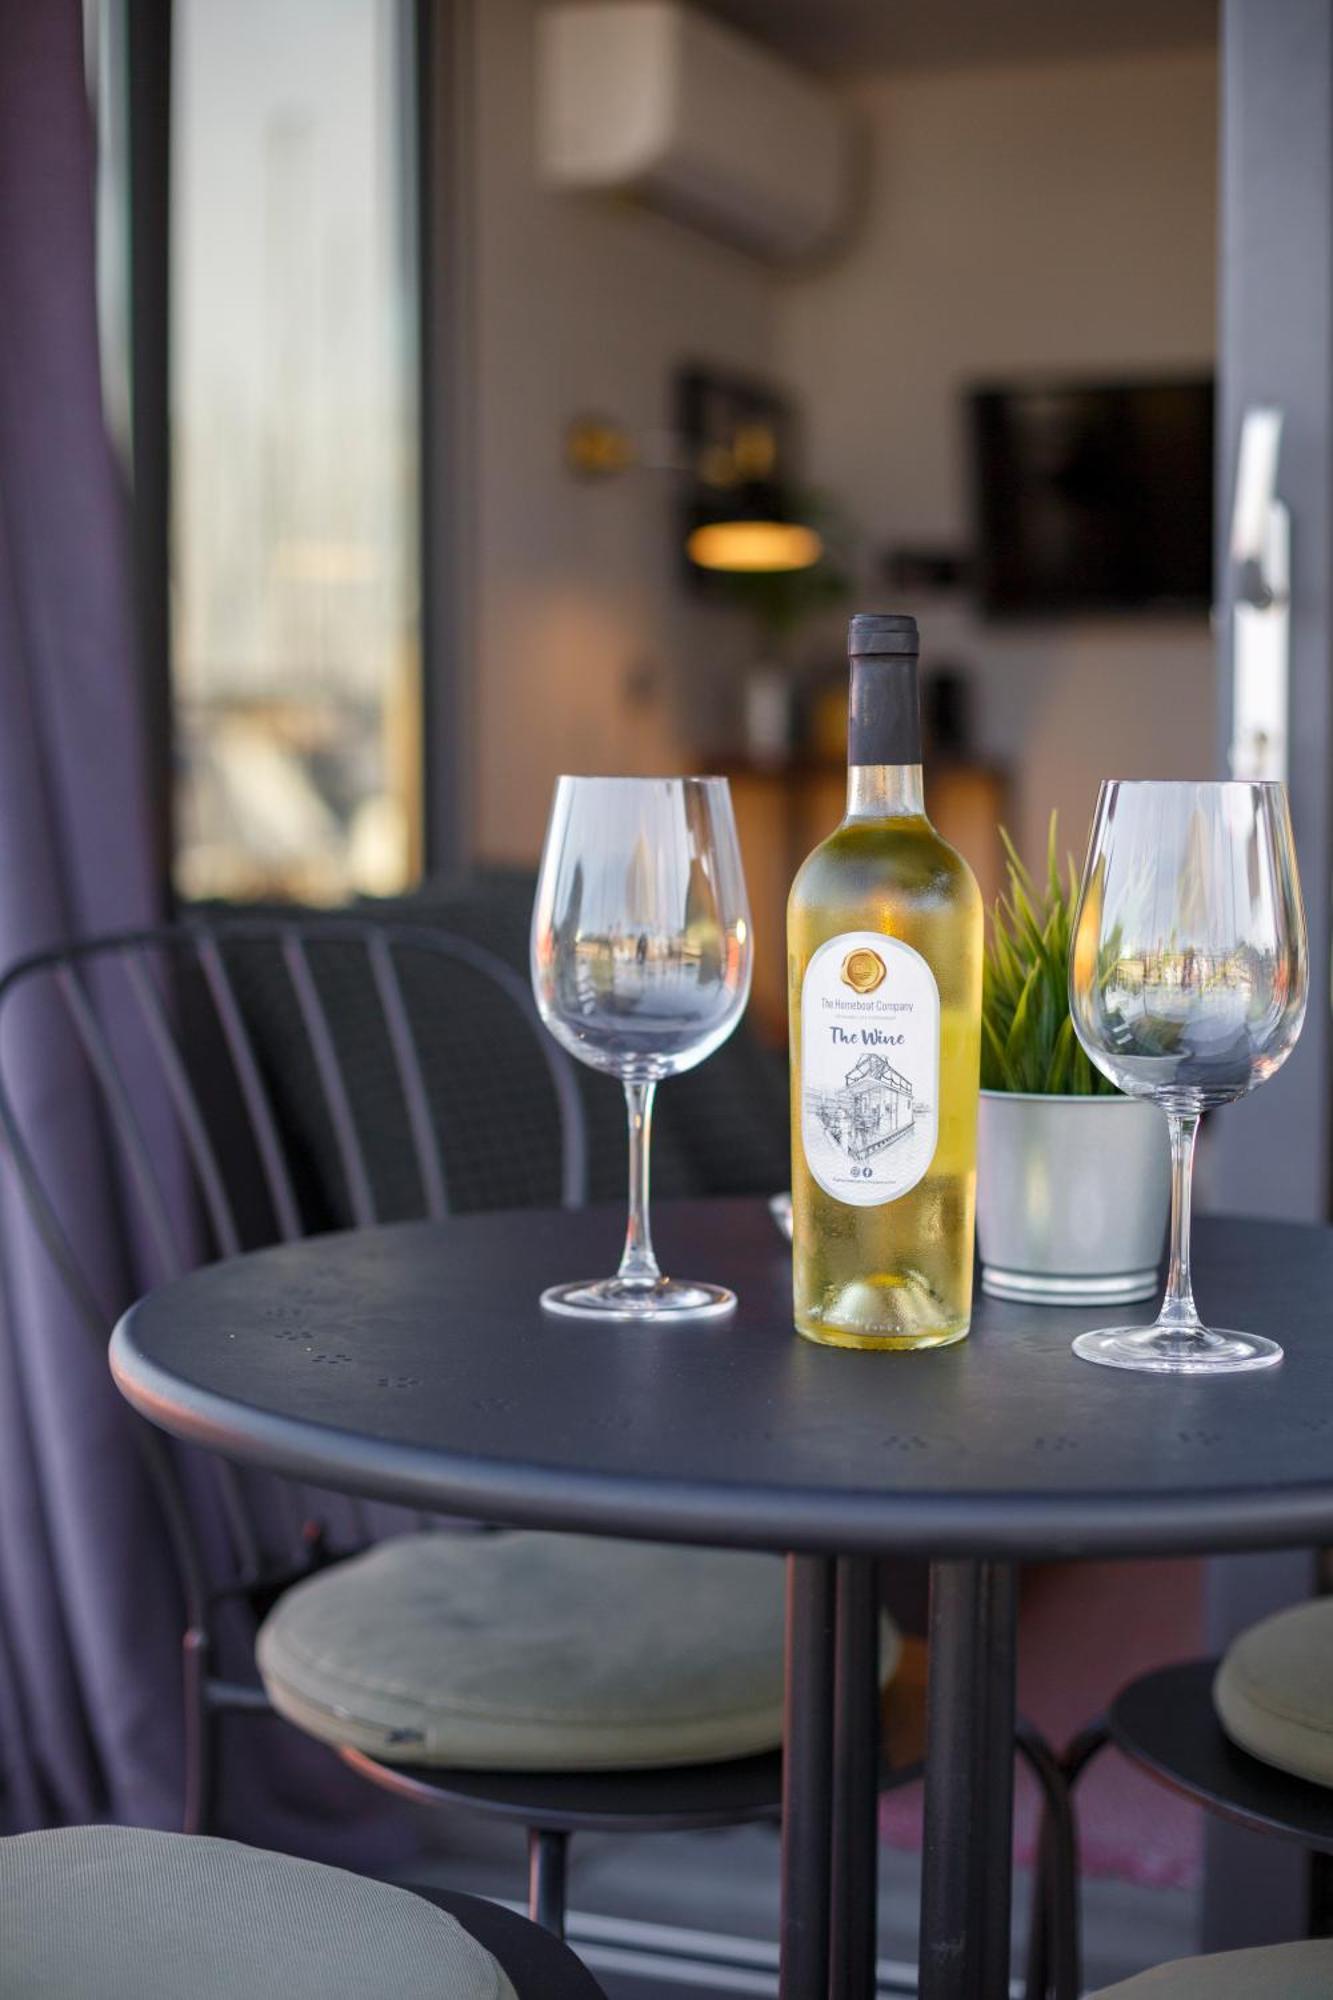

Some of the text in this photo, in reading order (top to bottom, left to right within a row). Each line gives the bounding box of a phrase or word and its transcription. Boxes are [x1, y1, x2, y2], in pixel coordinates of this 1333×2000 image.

[821, 997, 914, 1013] The Homeboat Company
[829, 1026, 905, 1046] The Wine
